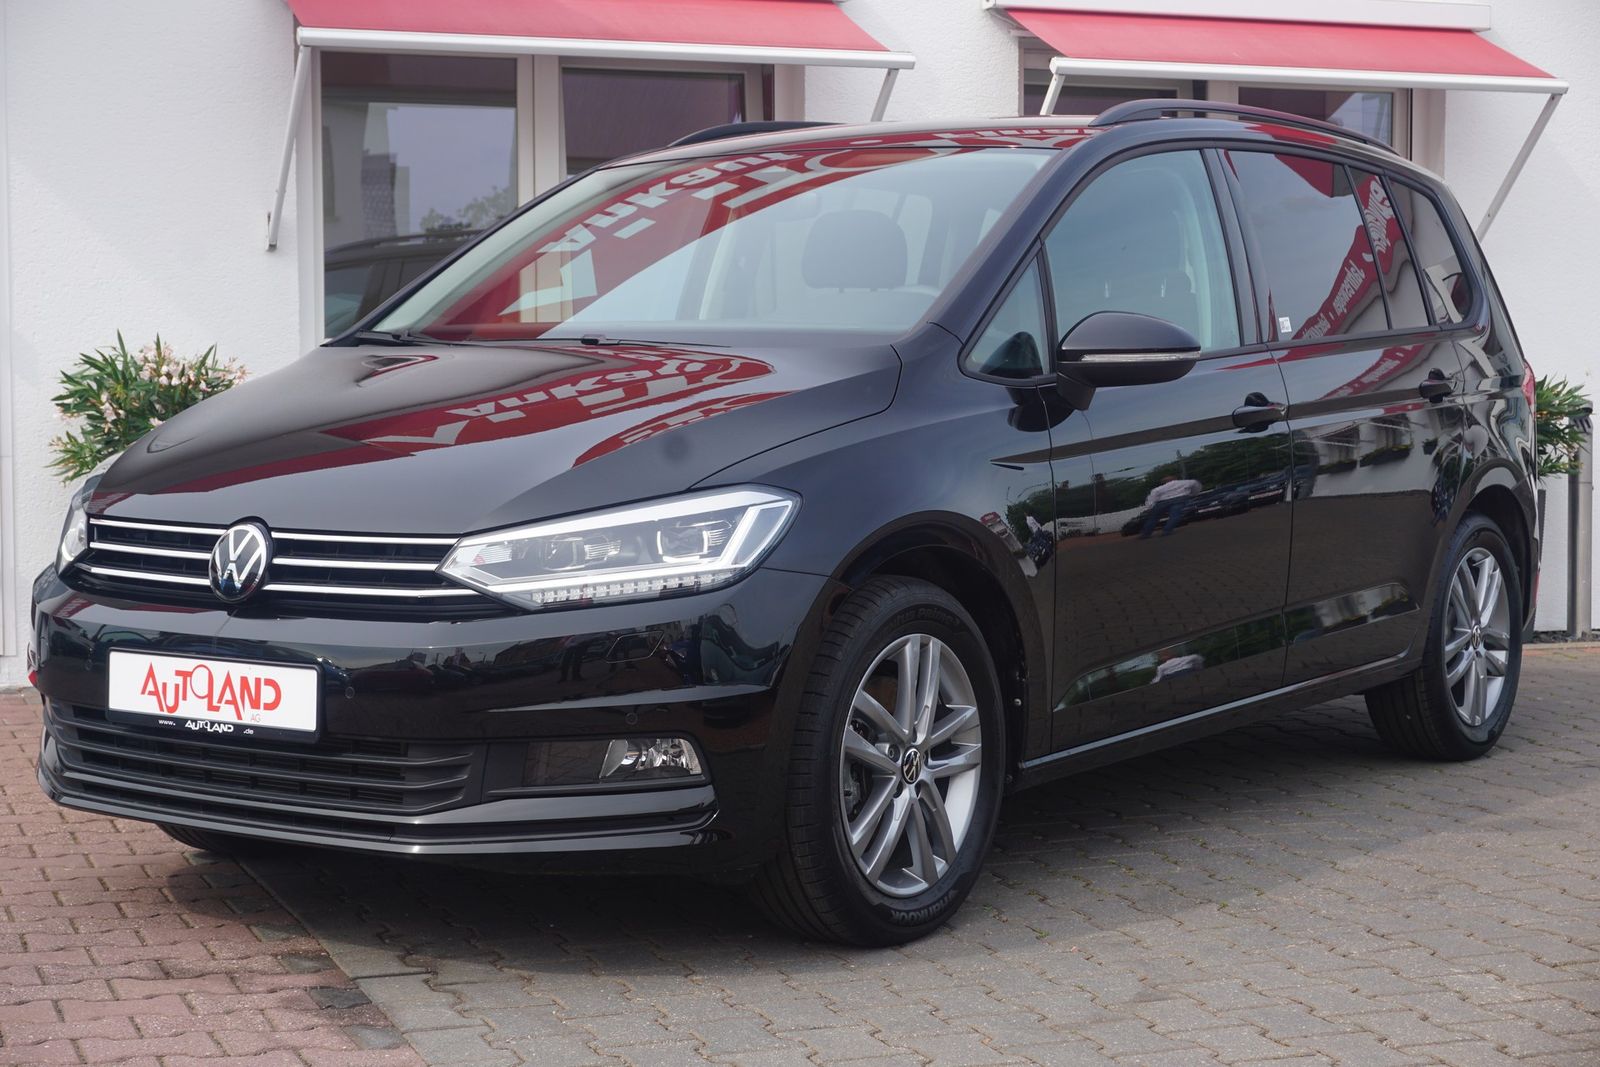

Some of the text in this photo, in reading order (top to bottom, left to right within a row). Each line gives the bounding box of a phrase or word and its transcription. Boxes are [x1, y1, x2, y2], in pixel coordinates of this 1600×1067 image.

[250, 713, 262, 724] AG
[158, 718, 176, 726] www.
[243, 727, 254, 736] .de
